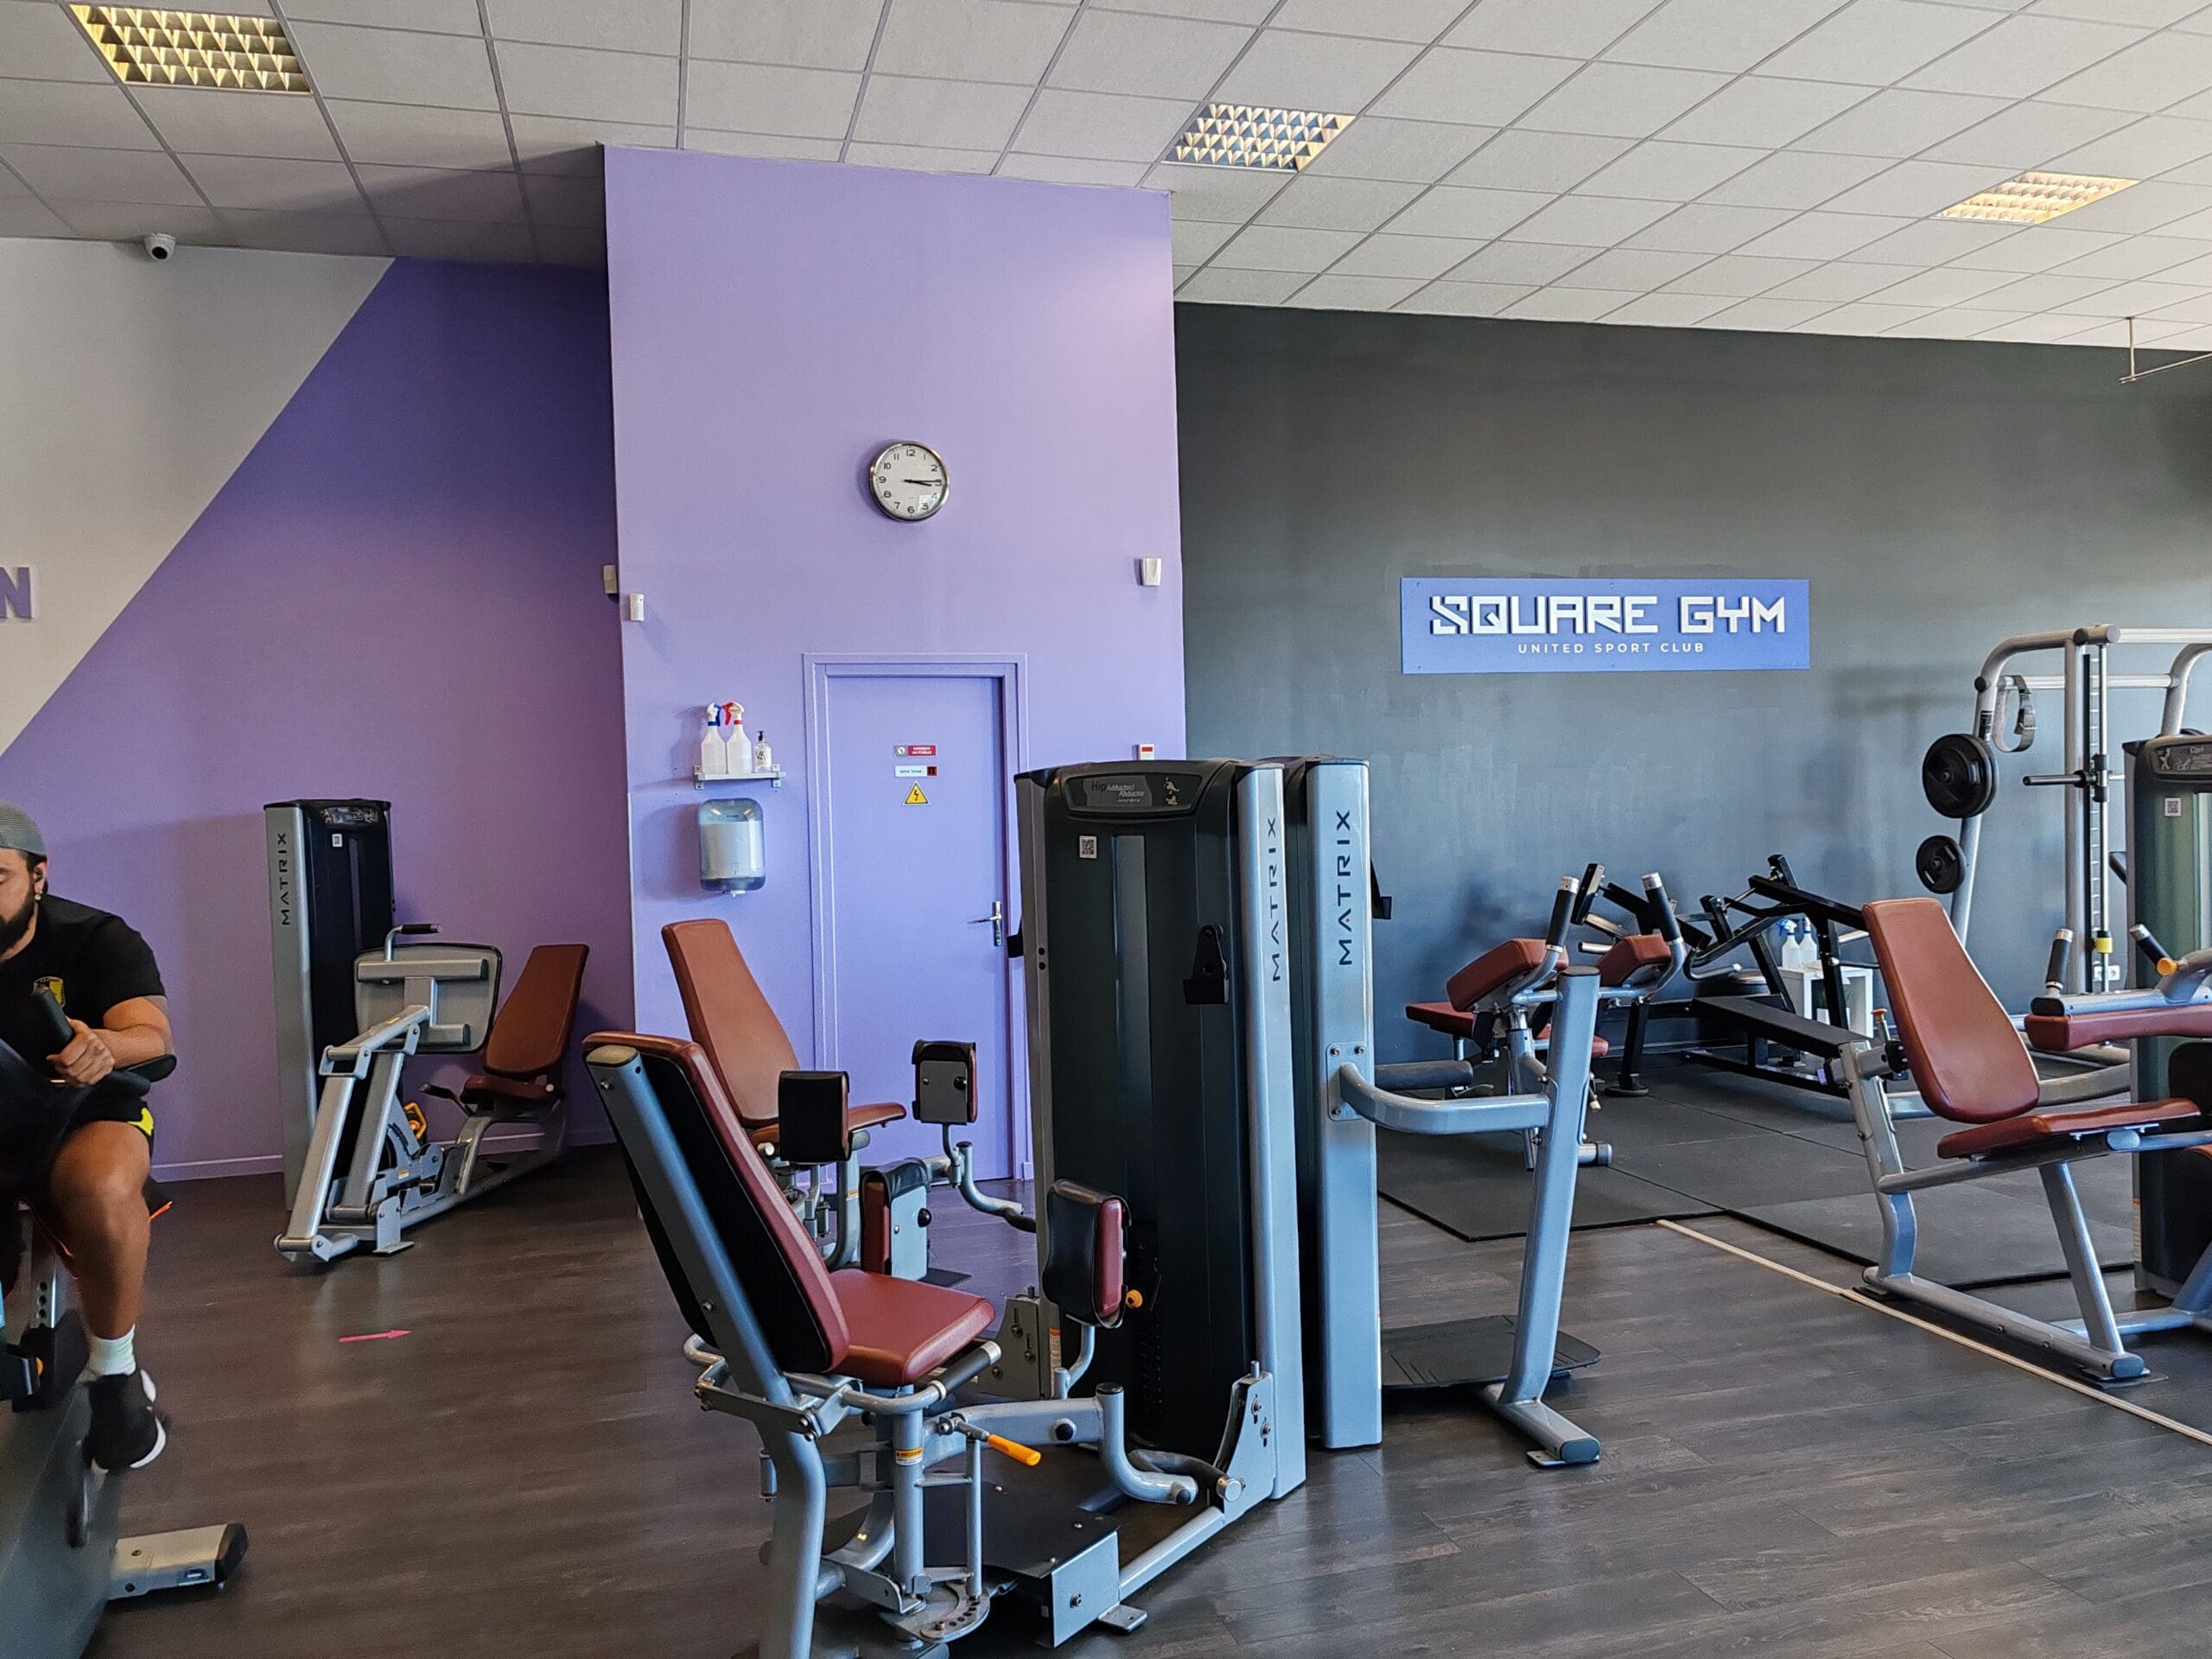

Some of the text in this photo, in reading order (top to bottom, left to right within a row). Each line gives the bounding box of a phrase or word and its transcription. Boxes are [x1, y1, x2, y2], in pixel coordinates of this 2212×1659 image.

[906, 448, 916, 457] 12
[930, 464, 938, 473] 2
[879, 475, 887, 484] 9
[893, 501, 901, 510] 7
[906, 505, 915, 514] 6
[1429, 594, 1785, 635] SQUARE GYM
[1517, 642, 1706, 654] UNITED SPORT CLUB
[1091, 780, 1107, 793] Hip
[277, 832, 290, 925] MATRIX
[1337, 810, 1352, 965] MATRIX
[1268, 817, 1281, 982] MATRIX
